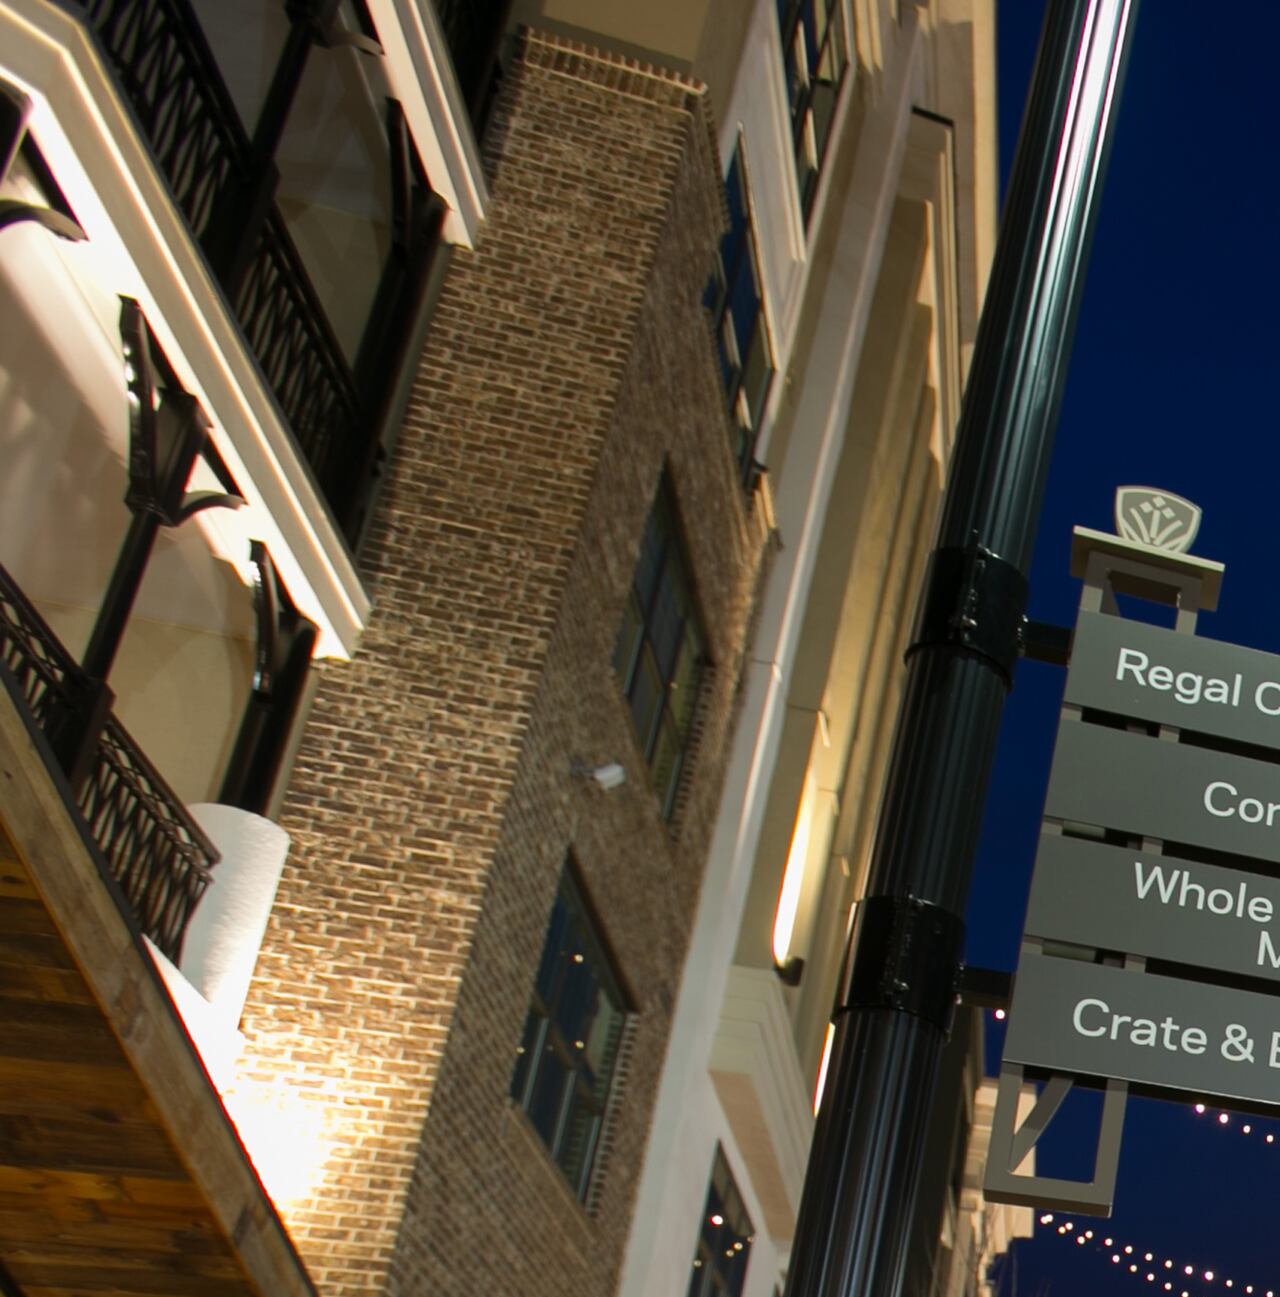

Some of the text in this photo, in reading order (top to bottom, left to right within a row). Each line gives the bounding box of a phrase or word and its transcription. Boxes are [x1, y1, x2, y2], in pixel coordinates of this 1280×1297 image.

[1115, 647, 1242, 705] Regal
[1134, 861, 1274, 924] Whole
[1072, 997, 1208, 1056] Crate
[1220, 1023, 1256, 1064] &
